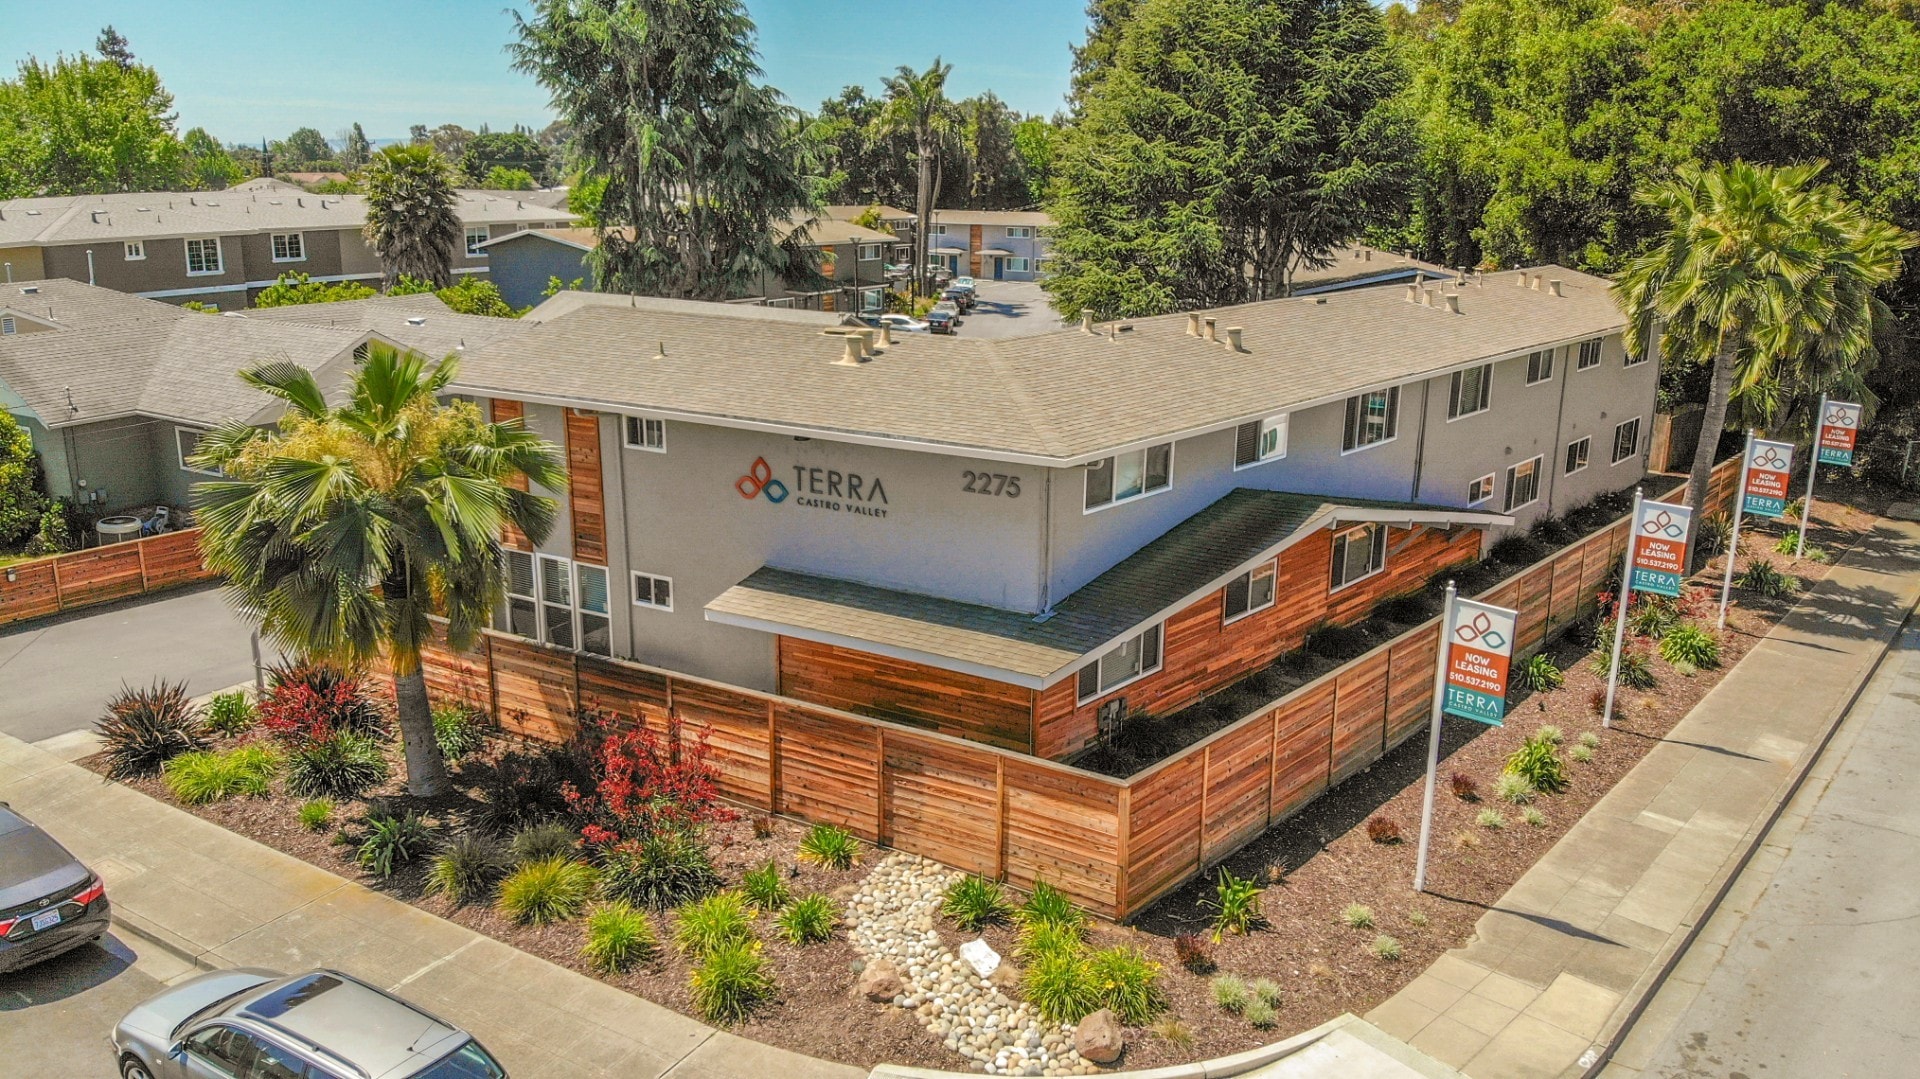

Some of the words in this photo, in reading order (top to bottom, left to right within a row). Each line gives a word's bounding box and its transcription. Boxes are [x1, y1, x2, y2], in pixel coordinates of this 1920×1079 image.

[1821, 449, 1848, 459] TERRA
[1752, 478, 1781, 488] LEASING
[1759, 472, 1776, 481] NOW
[792, 465, 888, 505] TERRA
[961, 470, 1021, 499] 2275
[796, 496, 841, 512] CASTRO
[846, 504, 887, 519] VALLEY
[1747, 496, 1780, 509] TERRA
[1649, 541, 1670, 552] NOW
[1641, 548, 1676, 561] LEASING
[1636, 558, 1679, 571] 510.537.2190
[1635, 570, 1676, 587] TERRA
[1465, 652, 1490, 666] NOW
[1455, 660, 1498, 679] LEASING
[1449, 671, 1501, 692] 510.537.2190
[1448, 688, 1498, 713] TERRA
[1448, 701, 1473, 712] CASTRO
[1475, 707, 1498, 718] VALLEY
